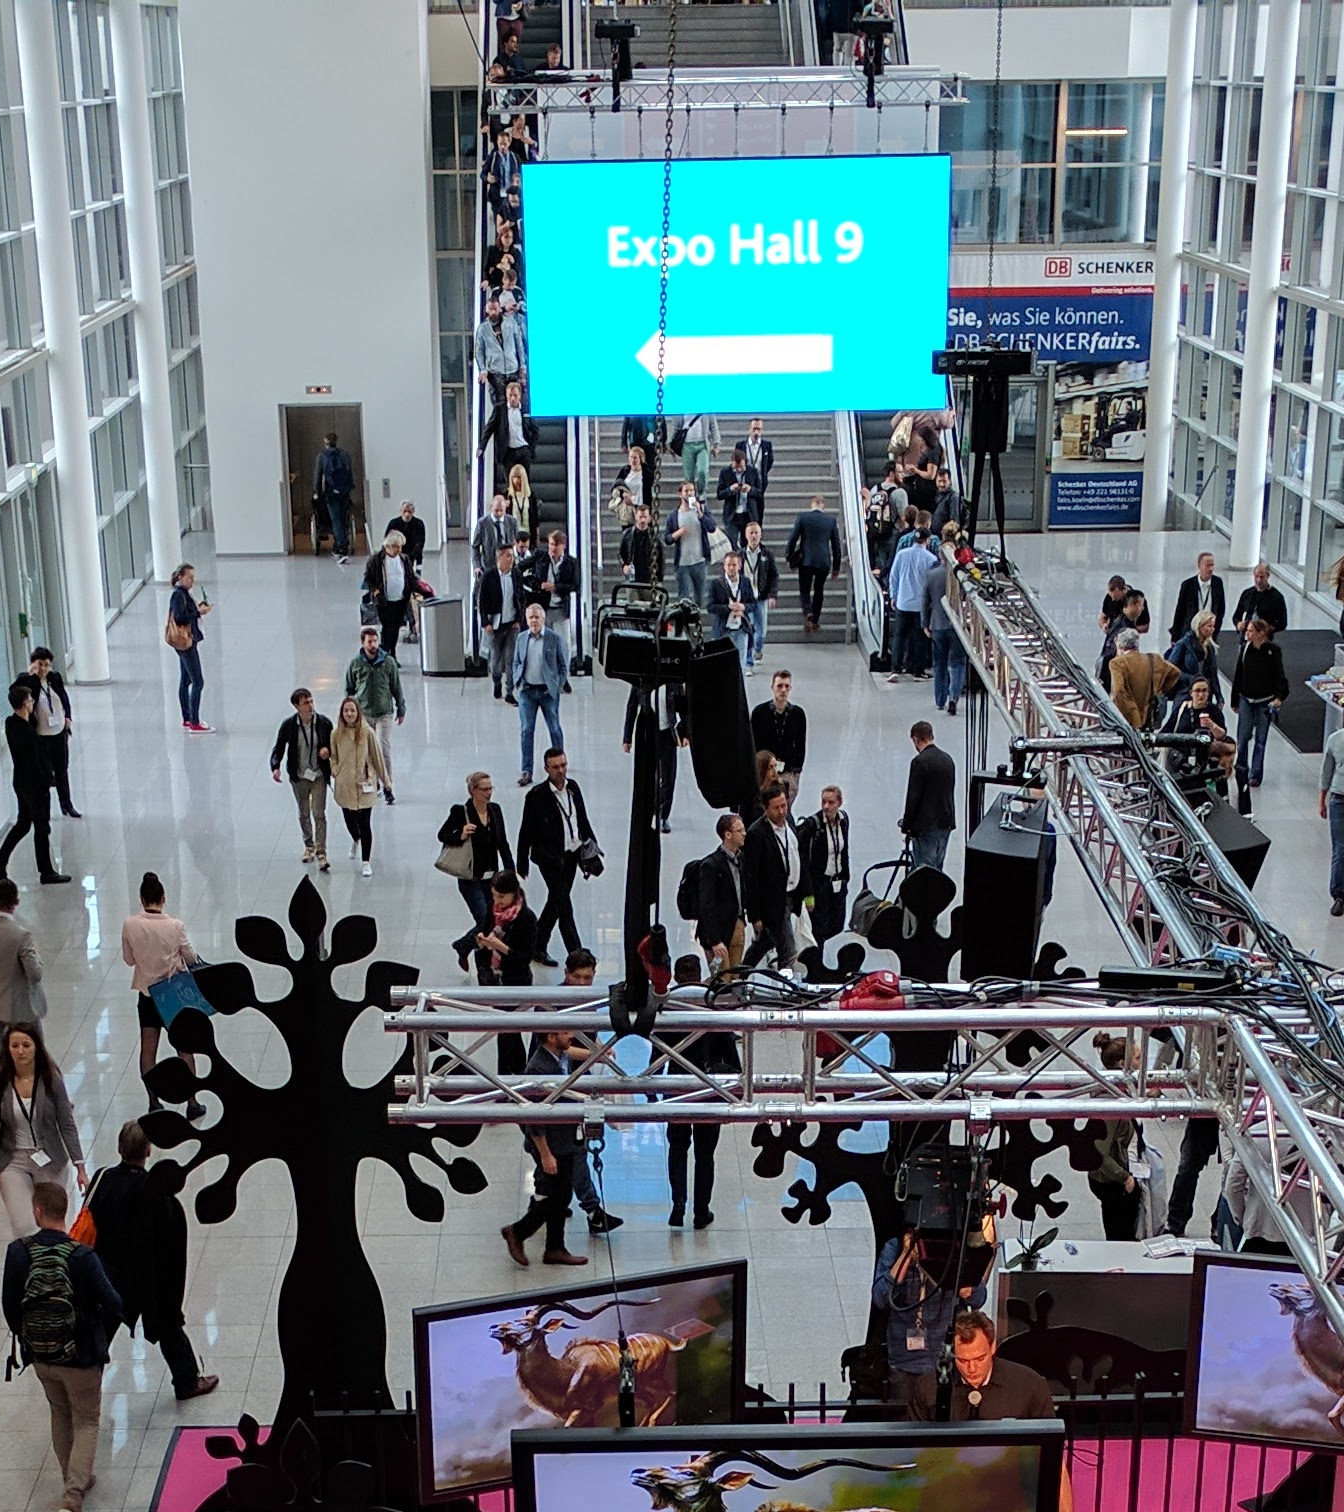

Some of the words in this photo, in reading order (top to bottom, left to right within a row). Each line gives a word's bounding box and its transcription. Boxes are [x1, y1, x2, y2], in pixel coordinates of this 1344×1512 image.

[607, 224, 716, 278] Expo
[729, 219, 822, 265] Hall
[834, 220, 864, 264] 9
[1047, 260, 1069, 275] DB
[1077, 260, 1154, 275] SCHENKER
[947, 307, 983, 328] Sie,
[988, 312, 1020, 326] was
[1024, 307, 1051, 325] Sie
[1055, 306, 1124, 325] können.
